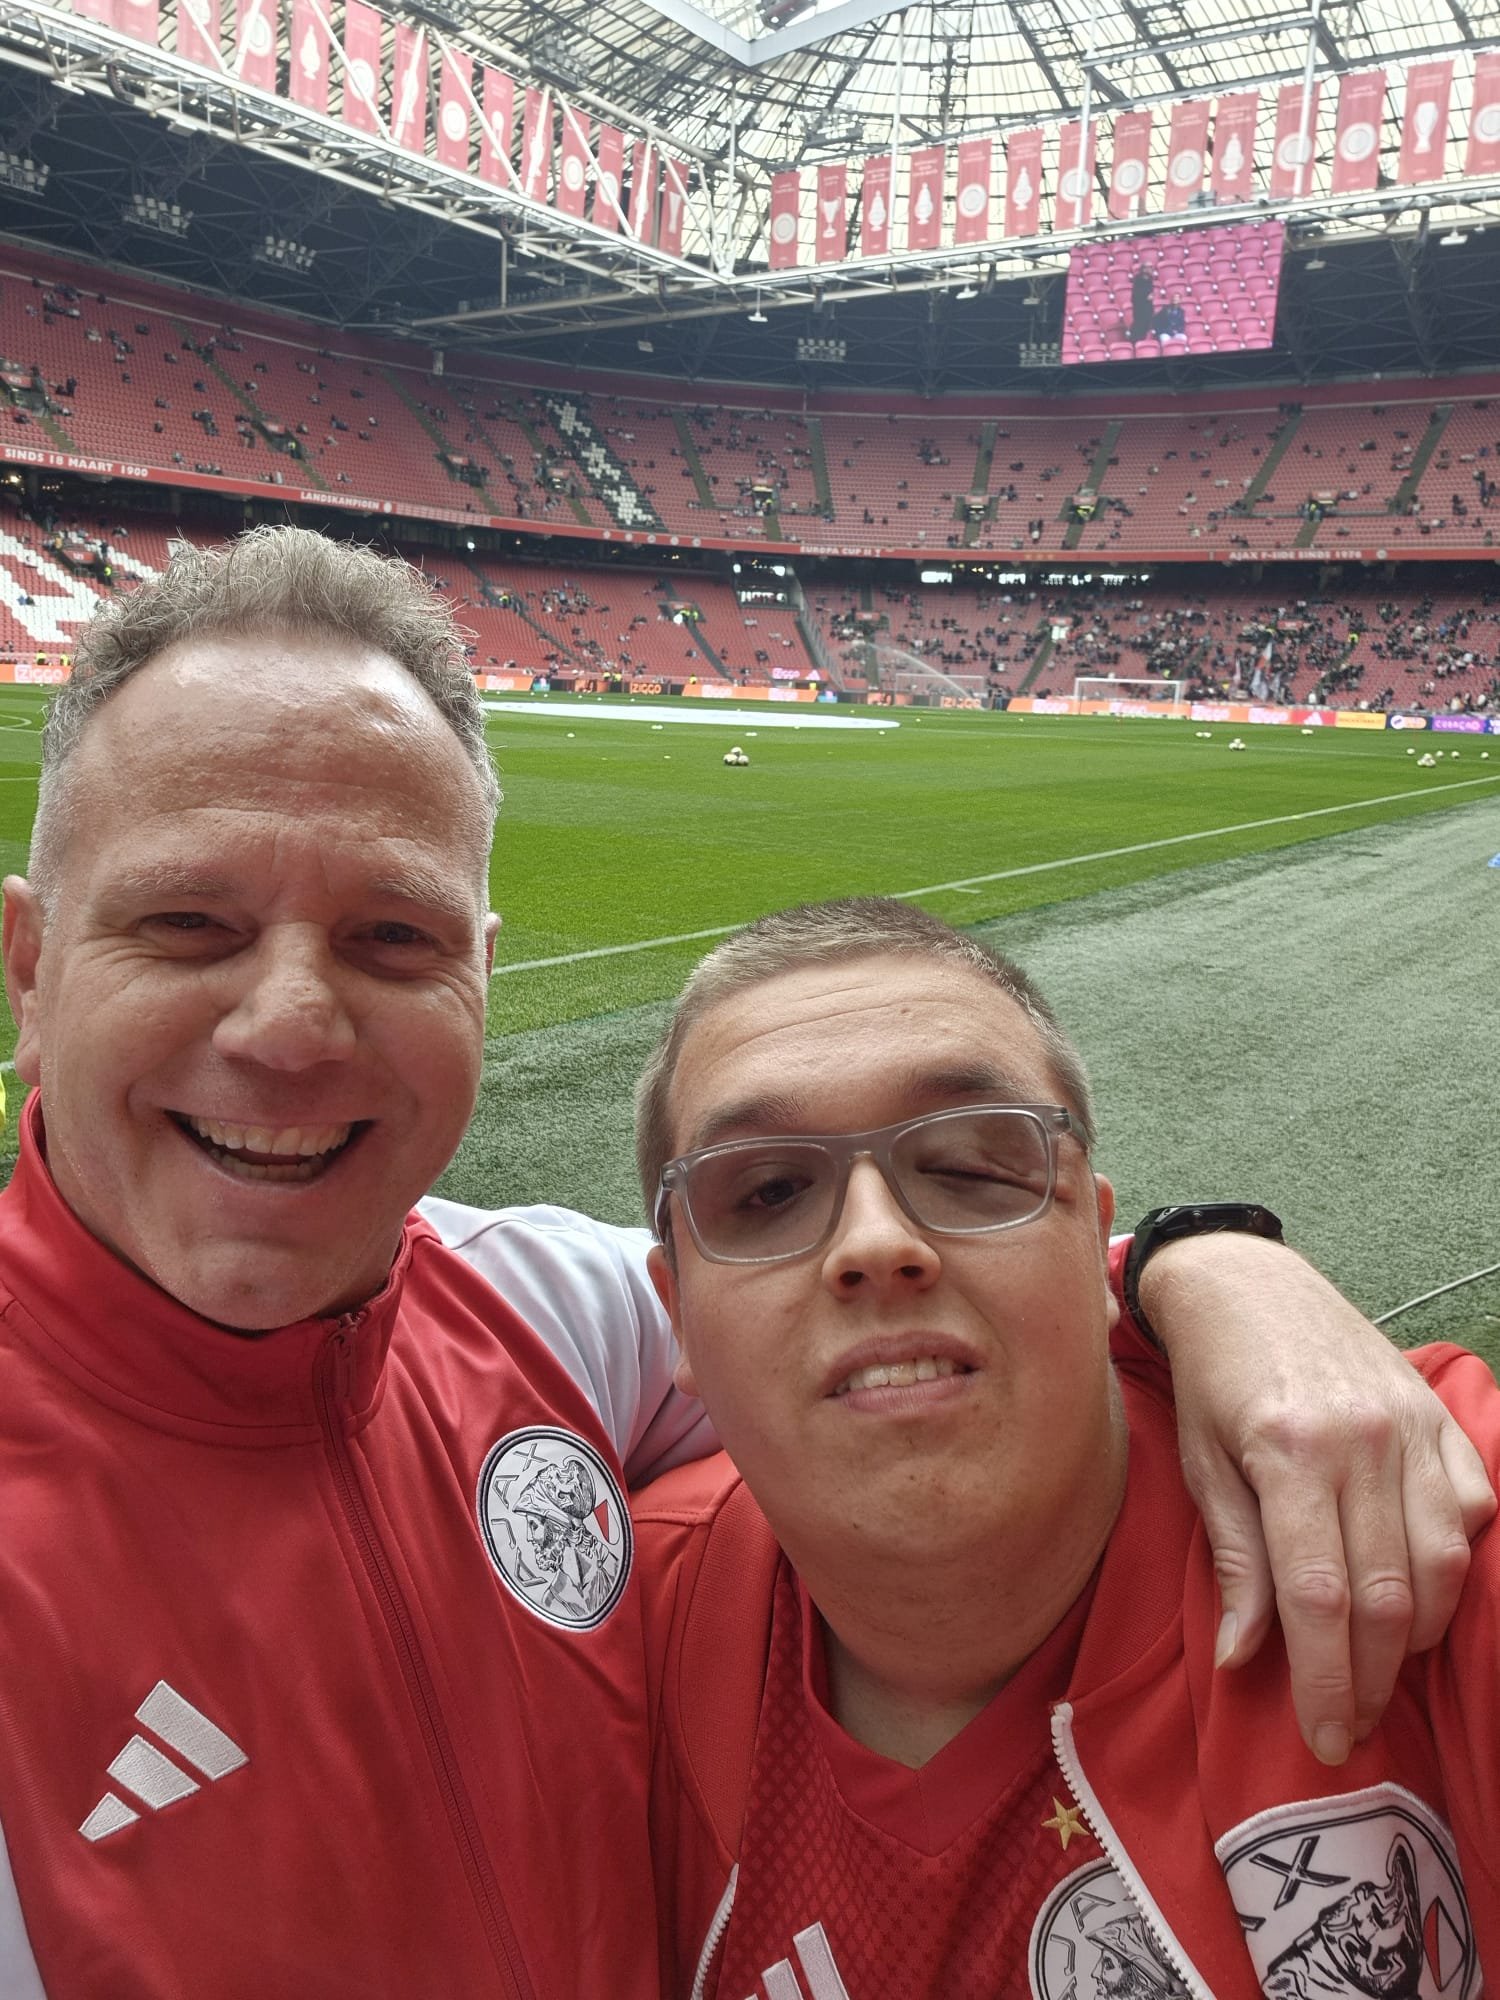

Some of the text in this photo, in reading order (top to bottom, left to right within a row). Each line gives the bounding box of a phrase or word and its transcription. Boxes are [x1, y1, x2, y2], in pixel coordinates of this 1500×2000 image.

[5, 448, 148, 477] SINDS 18 MAART 1900
[1229, 551, 1258, 560] AJAX
